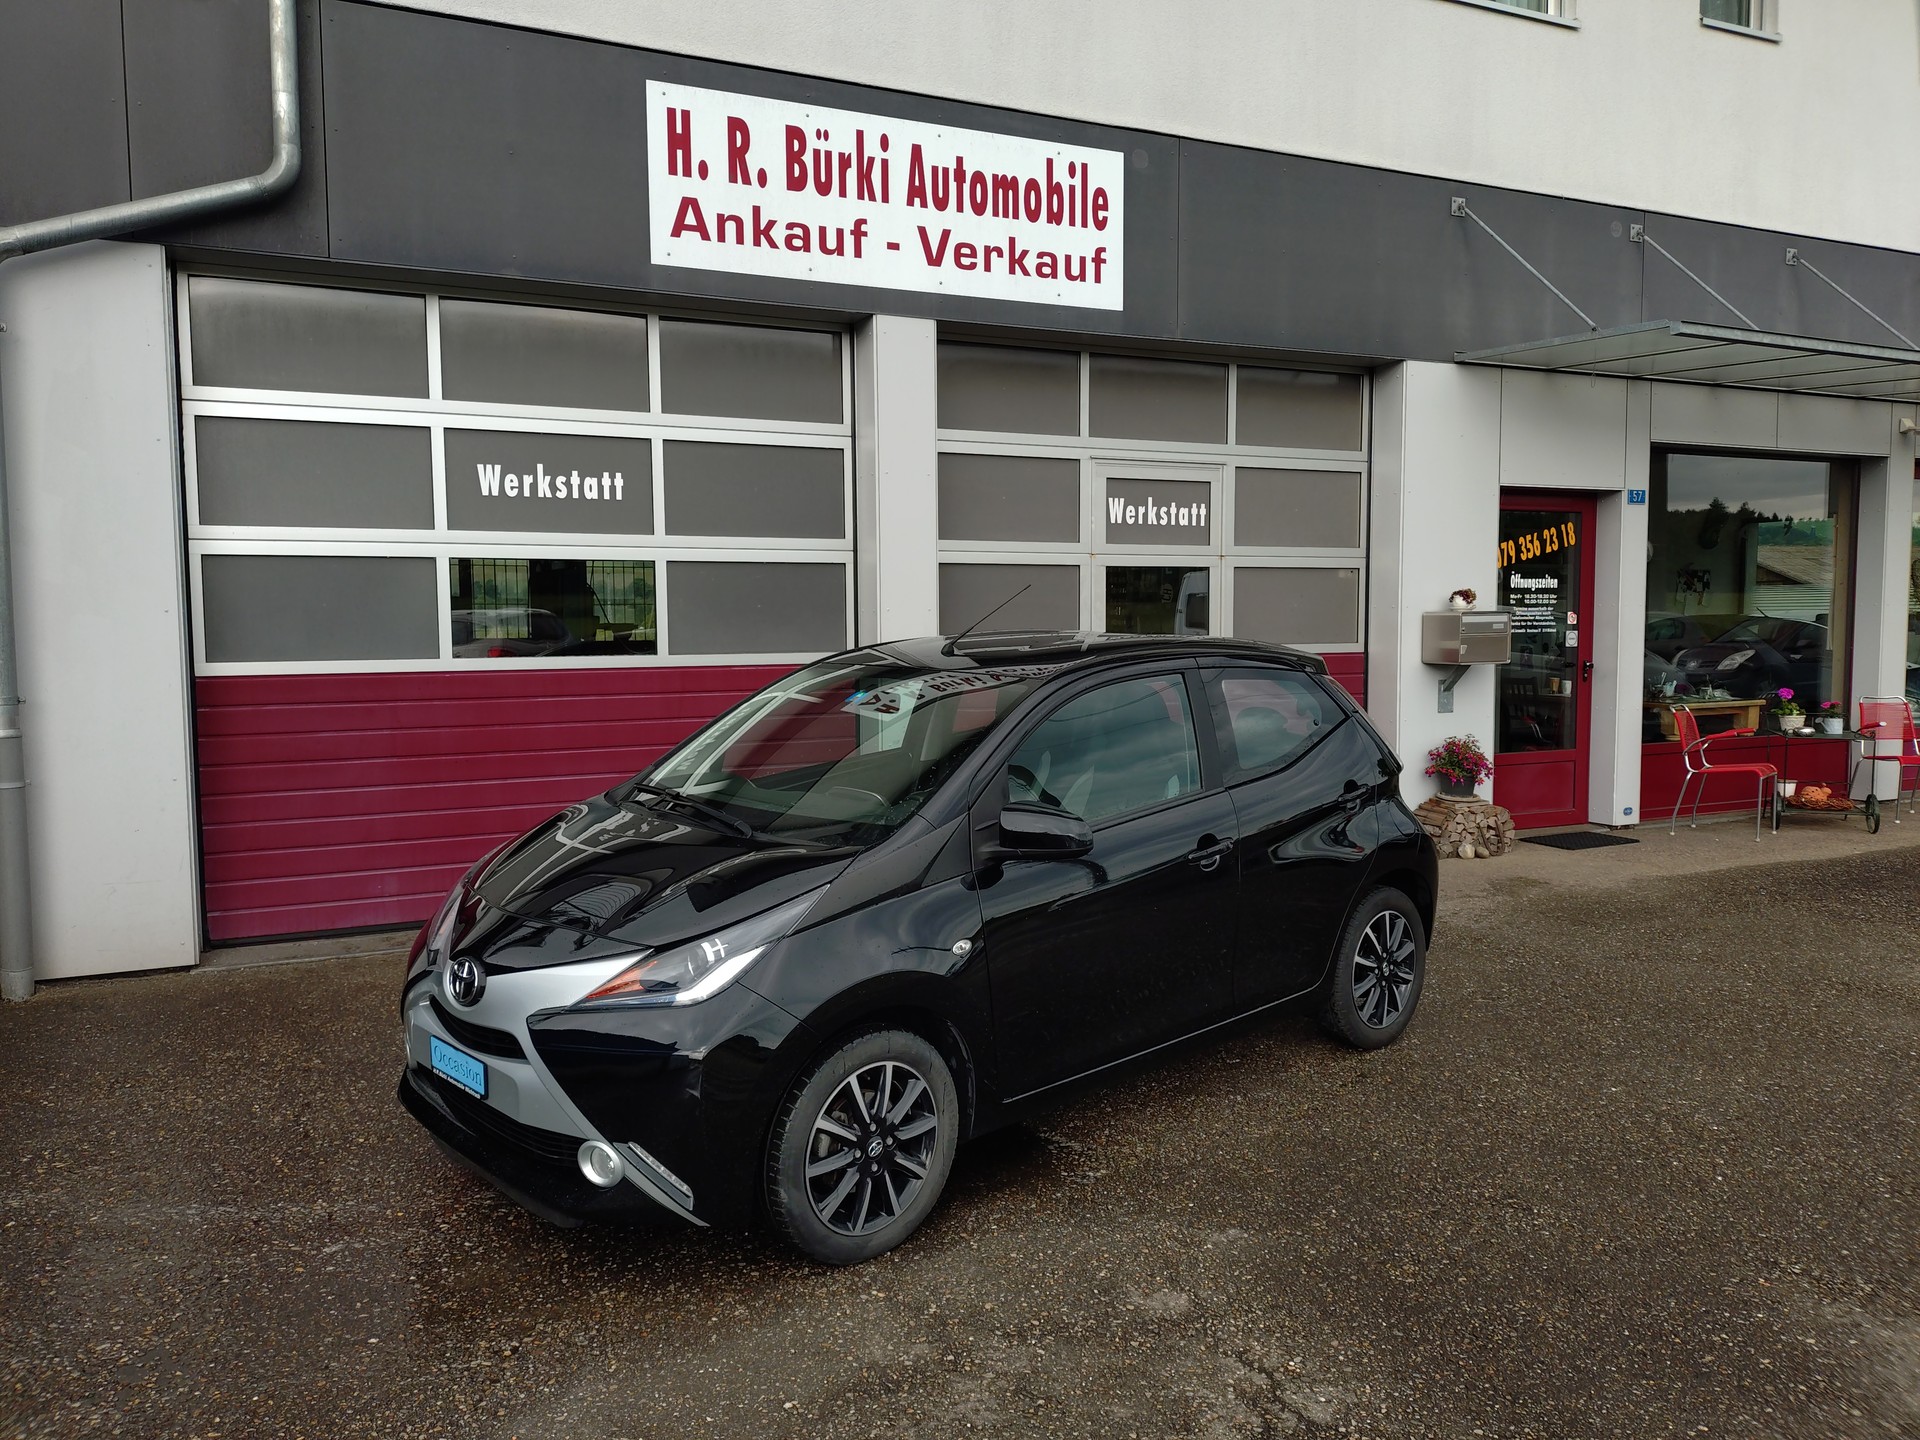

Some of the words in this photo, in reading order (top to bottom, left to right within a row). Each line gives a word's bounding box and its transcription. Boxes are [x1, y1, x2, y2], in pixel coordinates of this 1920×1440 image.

[666, 107, 709, 180] H.
[727, 116, 768, 189] R.
[785, 125, 890, 204] Bürki
[906, 143, 1109, 231] Automobile
[670, 196, 868, 259] Ankauf
[917, 225, 1107, 284] Verkauf
[476, 463, 624, 501] Werkstatt
[1632, 491, 1643, 502] 57
[1108, 496, 1207, 526] Werkstatt
[1518, 532, 1541, 561] 356
[1543, 526, 1559, 554] 23
[1560, 521, 1576, 548] 18
[1510, 571, 1558, 591] Öffnungszeiten
[434, 1045, 482, 1086] Occasion
